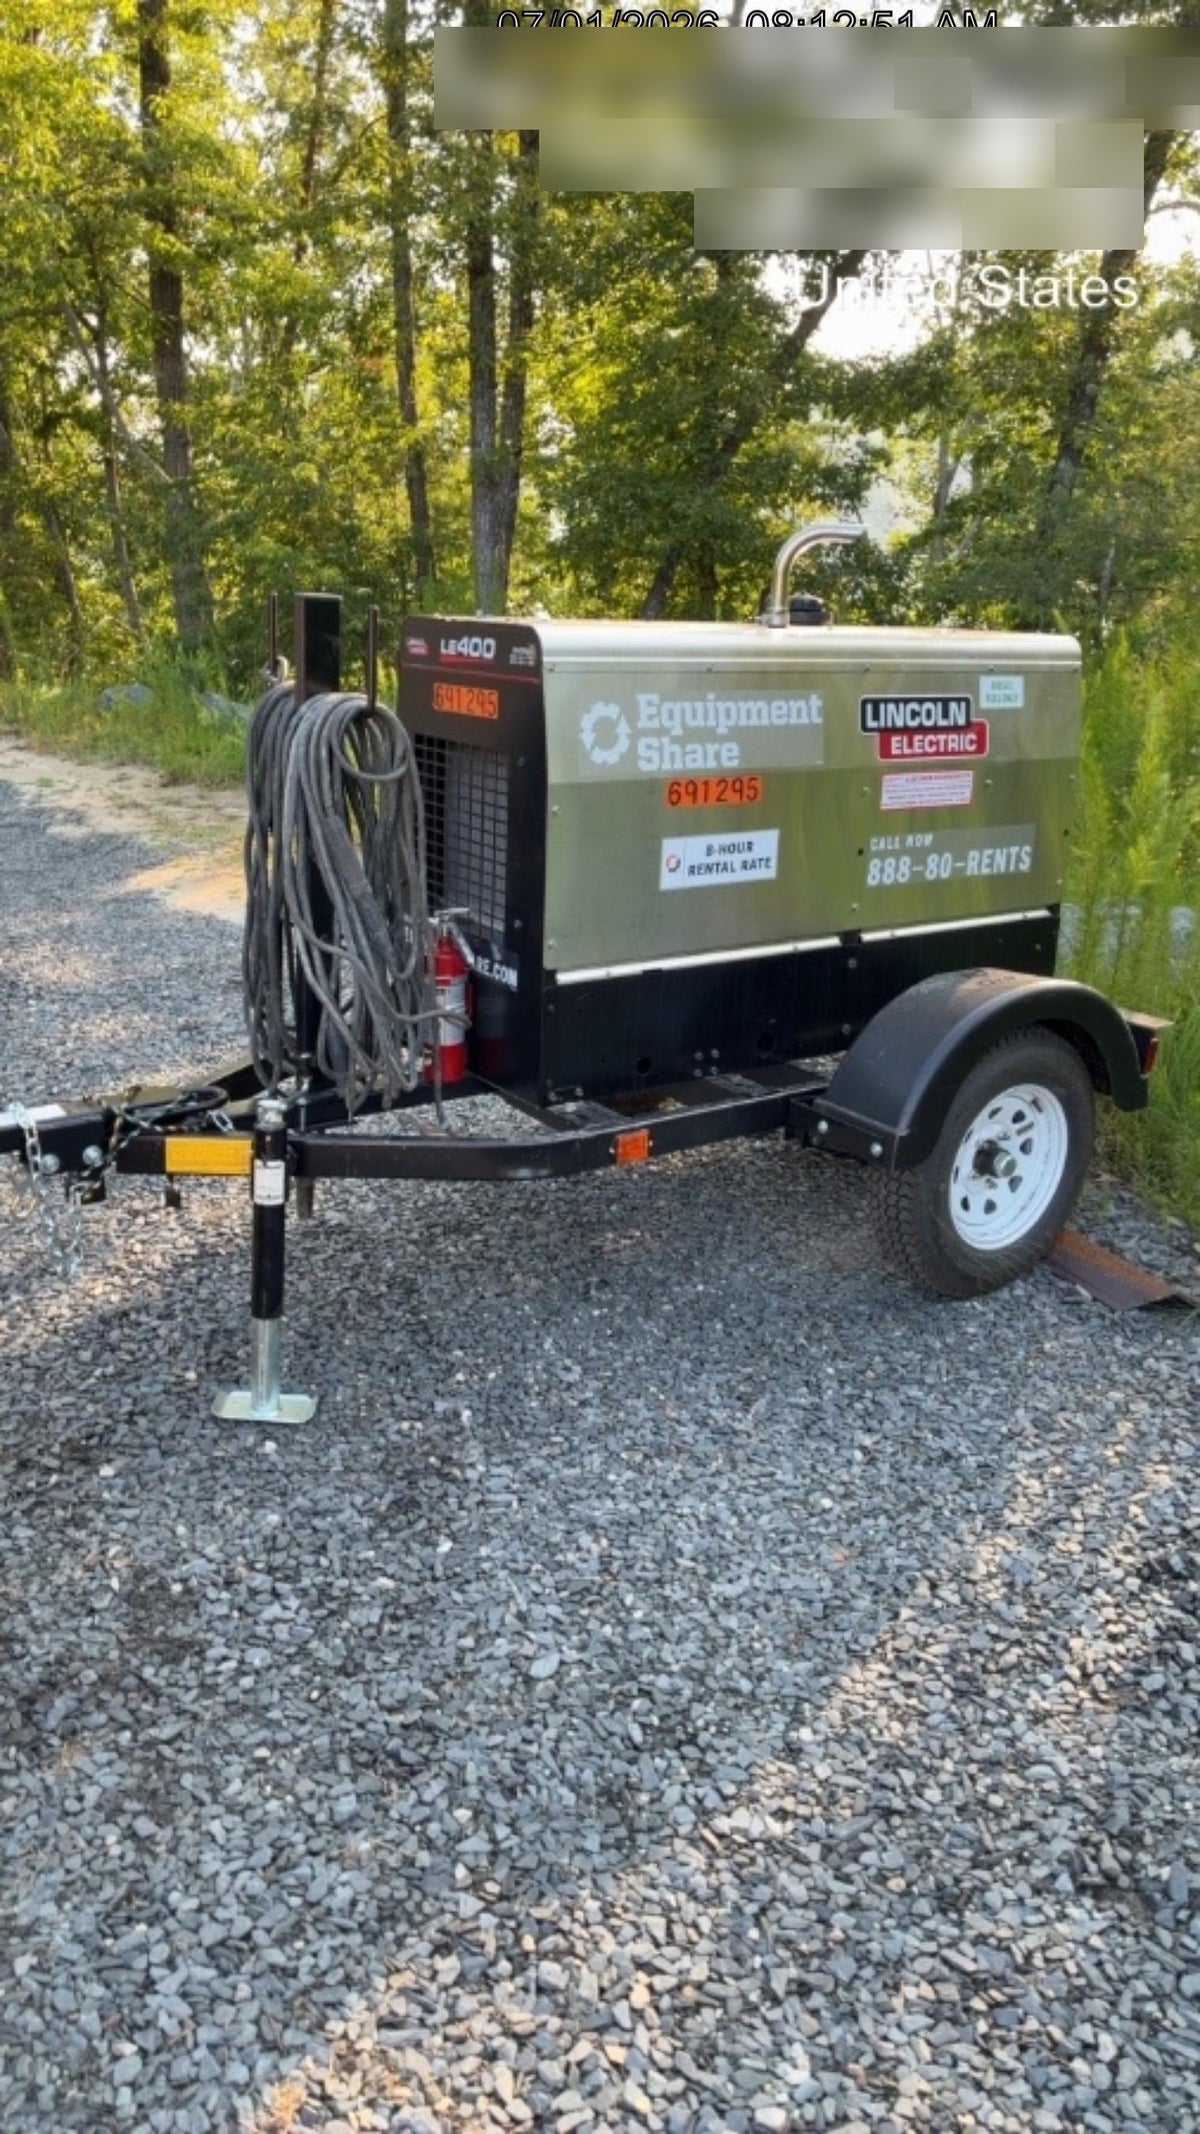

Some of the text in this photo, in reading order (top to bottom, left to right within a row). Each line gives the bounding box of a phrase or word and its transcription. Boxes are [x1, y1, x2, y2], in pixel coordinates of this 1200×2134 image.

[440, 636, 497, 660] LE400
[435, 684, 497, 717] 691295
[636, 693, 823, 735] Equipment
[865, 701, 966, 728] LINCOLN
[637, 737, 740, 771] Share
[891, 734, 978, 755] ELECTRIC
[667, 777, 759, 807] 691295
[706, 841, 754, 857] 8-HOUR
[870, 833, 933, 850] CALL NOW
[688, 857, 772, 877] RENTAL RATE
[867, 845, 1032, 886] 888-80-RENTS
